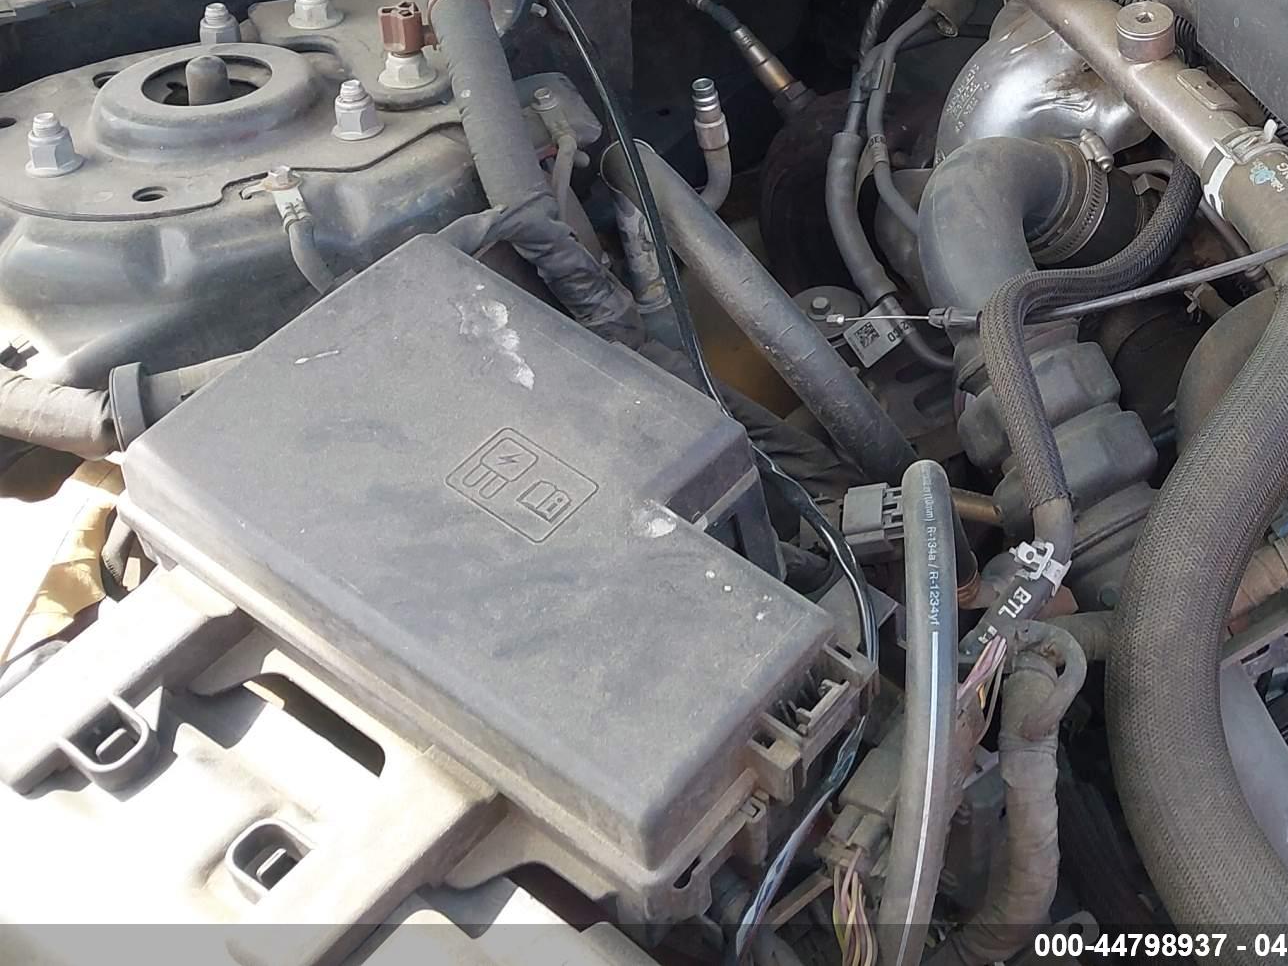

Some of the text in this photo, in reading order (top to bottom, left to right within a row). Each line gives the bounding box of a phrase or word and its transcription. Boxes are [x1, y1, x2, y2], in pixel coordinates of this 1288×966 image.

[927, 526, 938, 561] R-134a
[928, 571, 941, 625] R-1234yf
[998, 585, 1032, 618] BTL
